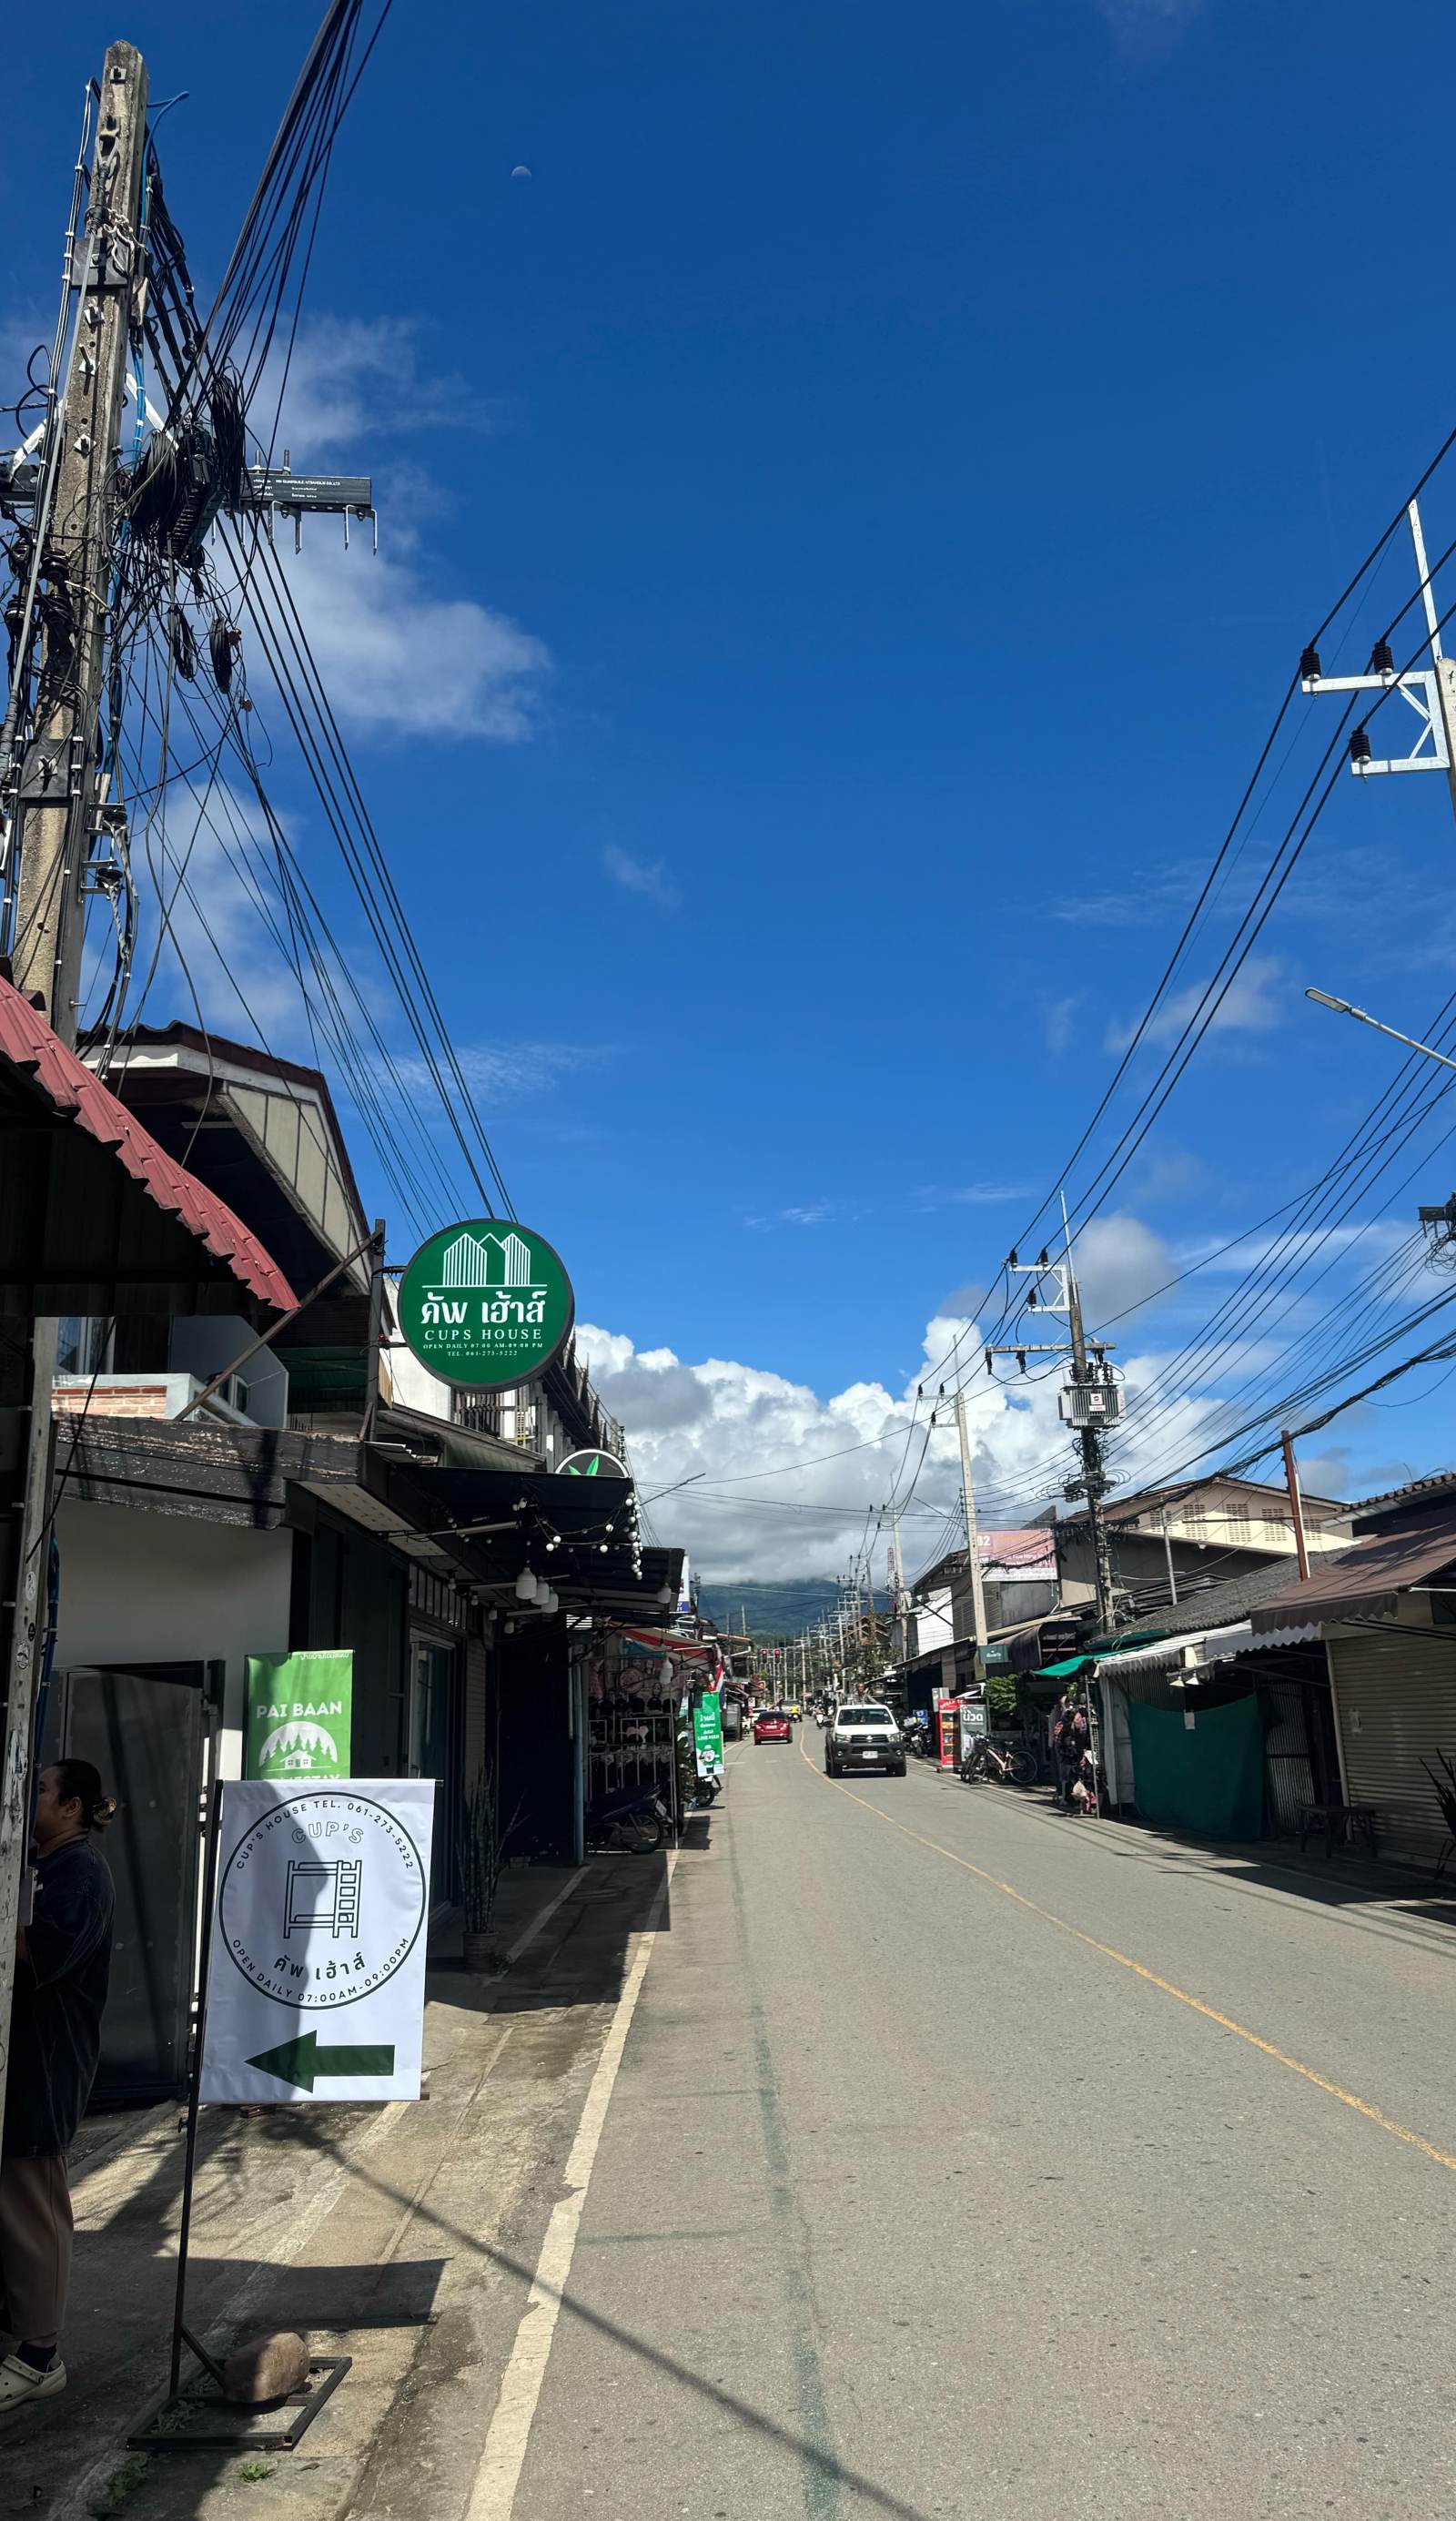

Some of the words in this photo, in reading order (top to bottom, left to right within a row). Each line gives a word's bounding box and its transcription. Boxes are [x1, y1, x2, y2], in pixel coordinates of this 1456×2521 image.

[420, 1291, 468, 1324] คัพ
[481, 1291, 548, 1324] เฮ้าส์
[424, 1330, 471, 1341] CUPS
[481, 1329, 541, 1340] HOUSE
[256, 1703, 288, 1718] PAI
[292, 1701, 342, 1716] BAAN
[236, 1832, 264, 1869] CUP'S
[265, 1803, 308, 1831] HOUSE
[313, 1799, 340, 1808] TEL.
[347, 1802, 414, 1869] 061-273-5222
[291, 1821, 364, 1844] CUP'S
[232, 1939, 256, 1972] OPEN
[257, 1972, 292, 1998] DAILY
[298, 1938, 410, 2003] 07:00AM-09:00PM
[274, 1954, 304, 1978] คัพ
[315, 1951, 366, 1980] เฮ้าส์
